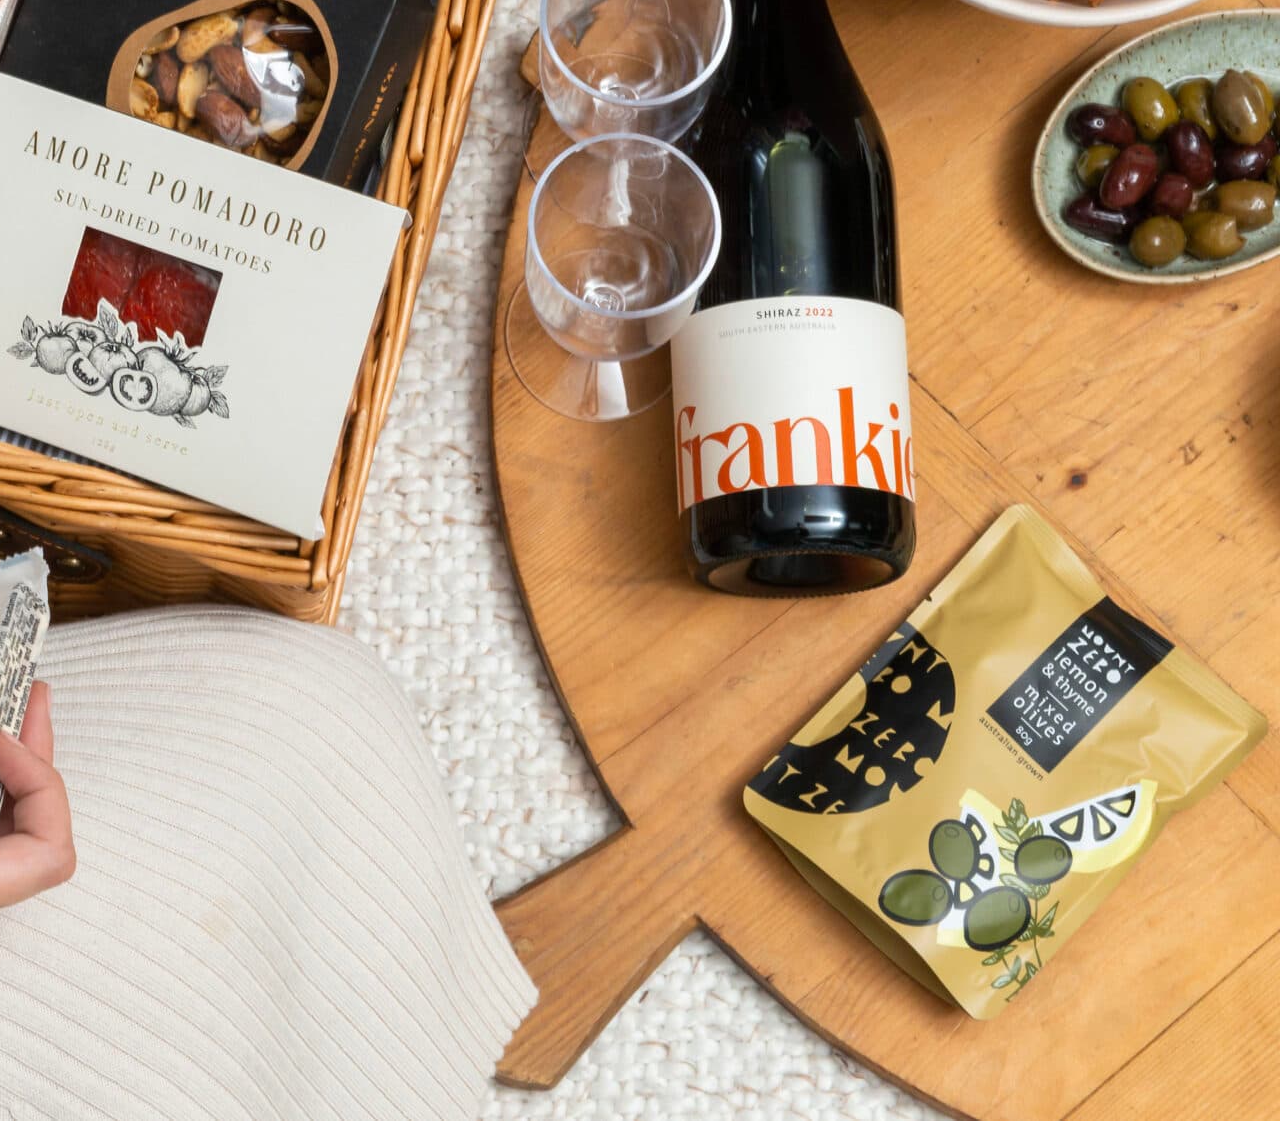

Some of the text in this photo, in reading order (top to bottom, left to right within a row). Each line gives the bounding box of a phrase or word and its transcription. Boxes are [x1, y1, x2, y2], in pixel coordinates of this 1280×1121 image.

[24, 130, 327, 252] AMORE POMADORO
[54, 188, 273, 274] SUN-DRIED TOMATOES
[756, 307, 833, 319] SHIRAZ 2022
[676, 386, 914, 515] franki
[1054, 646, 1108, 704] lemon
[1066, 636, 1121, 684] ZERO
[1024, 684, 1076, 735] mixed
[1042, 662, 1095, 717] & thyme
[978, 716, 1044, 781] australian grown
[1013, 697, 1064, 746] olives
[1015, 725, 1033, 746] 80g
